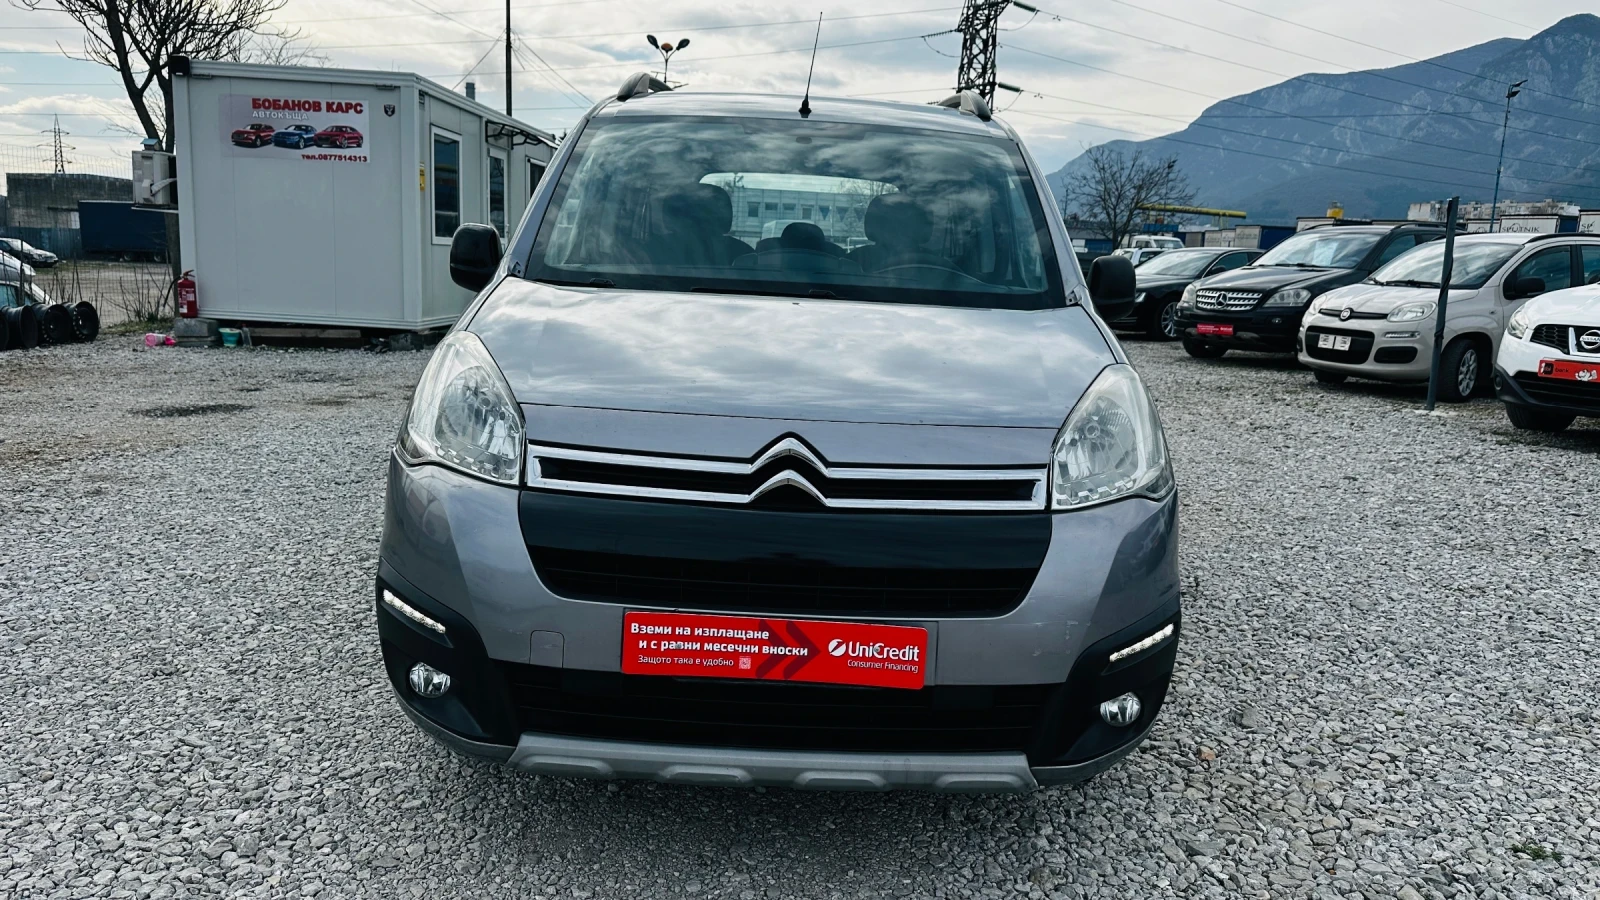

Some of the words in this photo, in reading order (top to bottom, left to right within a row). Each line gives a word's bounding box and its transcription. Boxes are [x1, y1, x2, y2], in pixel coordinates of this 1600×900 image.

[252, 97, 322, 112] БОБАНОВ
[326, 101, 364, 114] КАРС
[252, 111, 308, 121] АВТОКЪЩА
[301, 154, 367, 163] тел.0877514313
[630, 622, 672, 634] Вземи
[675, 627, 691, 635] на
[694, 627, 770, 640] изплащане
[638, 640, 647, 649] и
[650, 641, 657, 649] с
[660, 641, 700, 651] равни
[703, 642, 759, 653] месечни
[762, 646, 808, 656] вноски
[848, 641, 920, 661] UniCredit
[638, 655, 672, 665] Защото
[674, 656, 693, 664] така
[703, 656, 734, 666] удобно
[847, 660, 883, 669] Consumer
[884, 662, 919, 673] Financing
